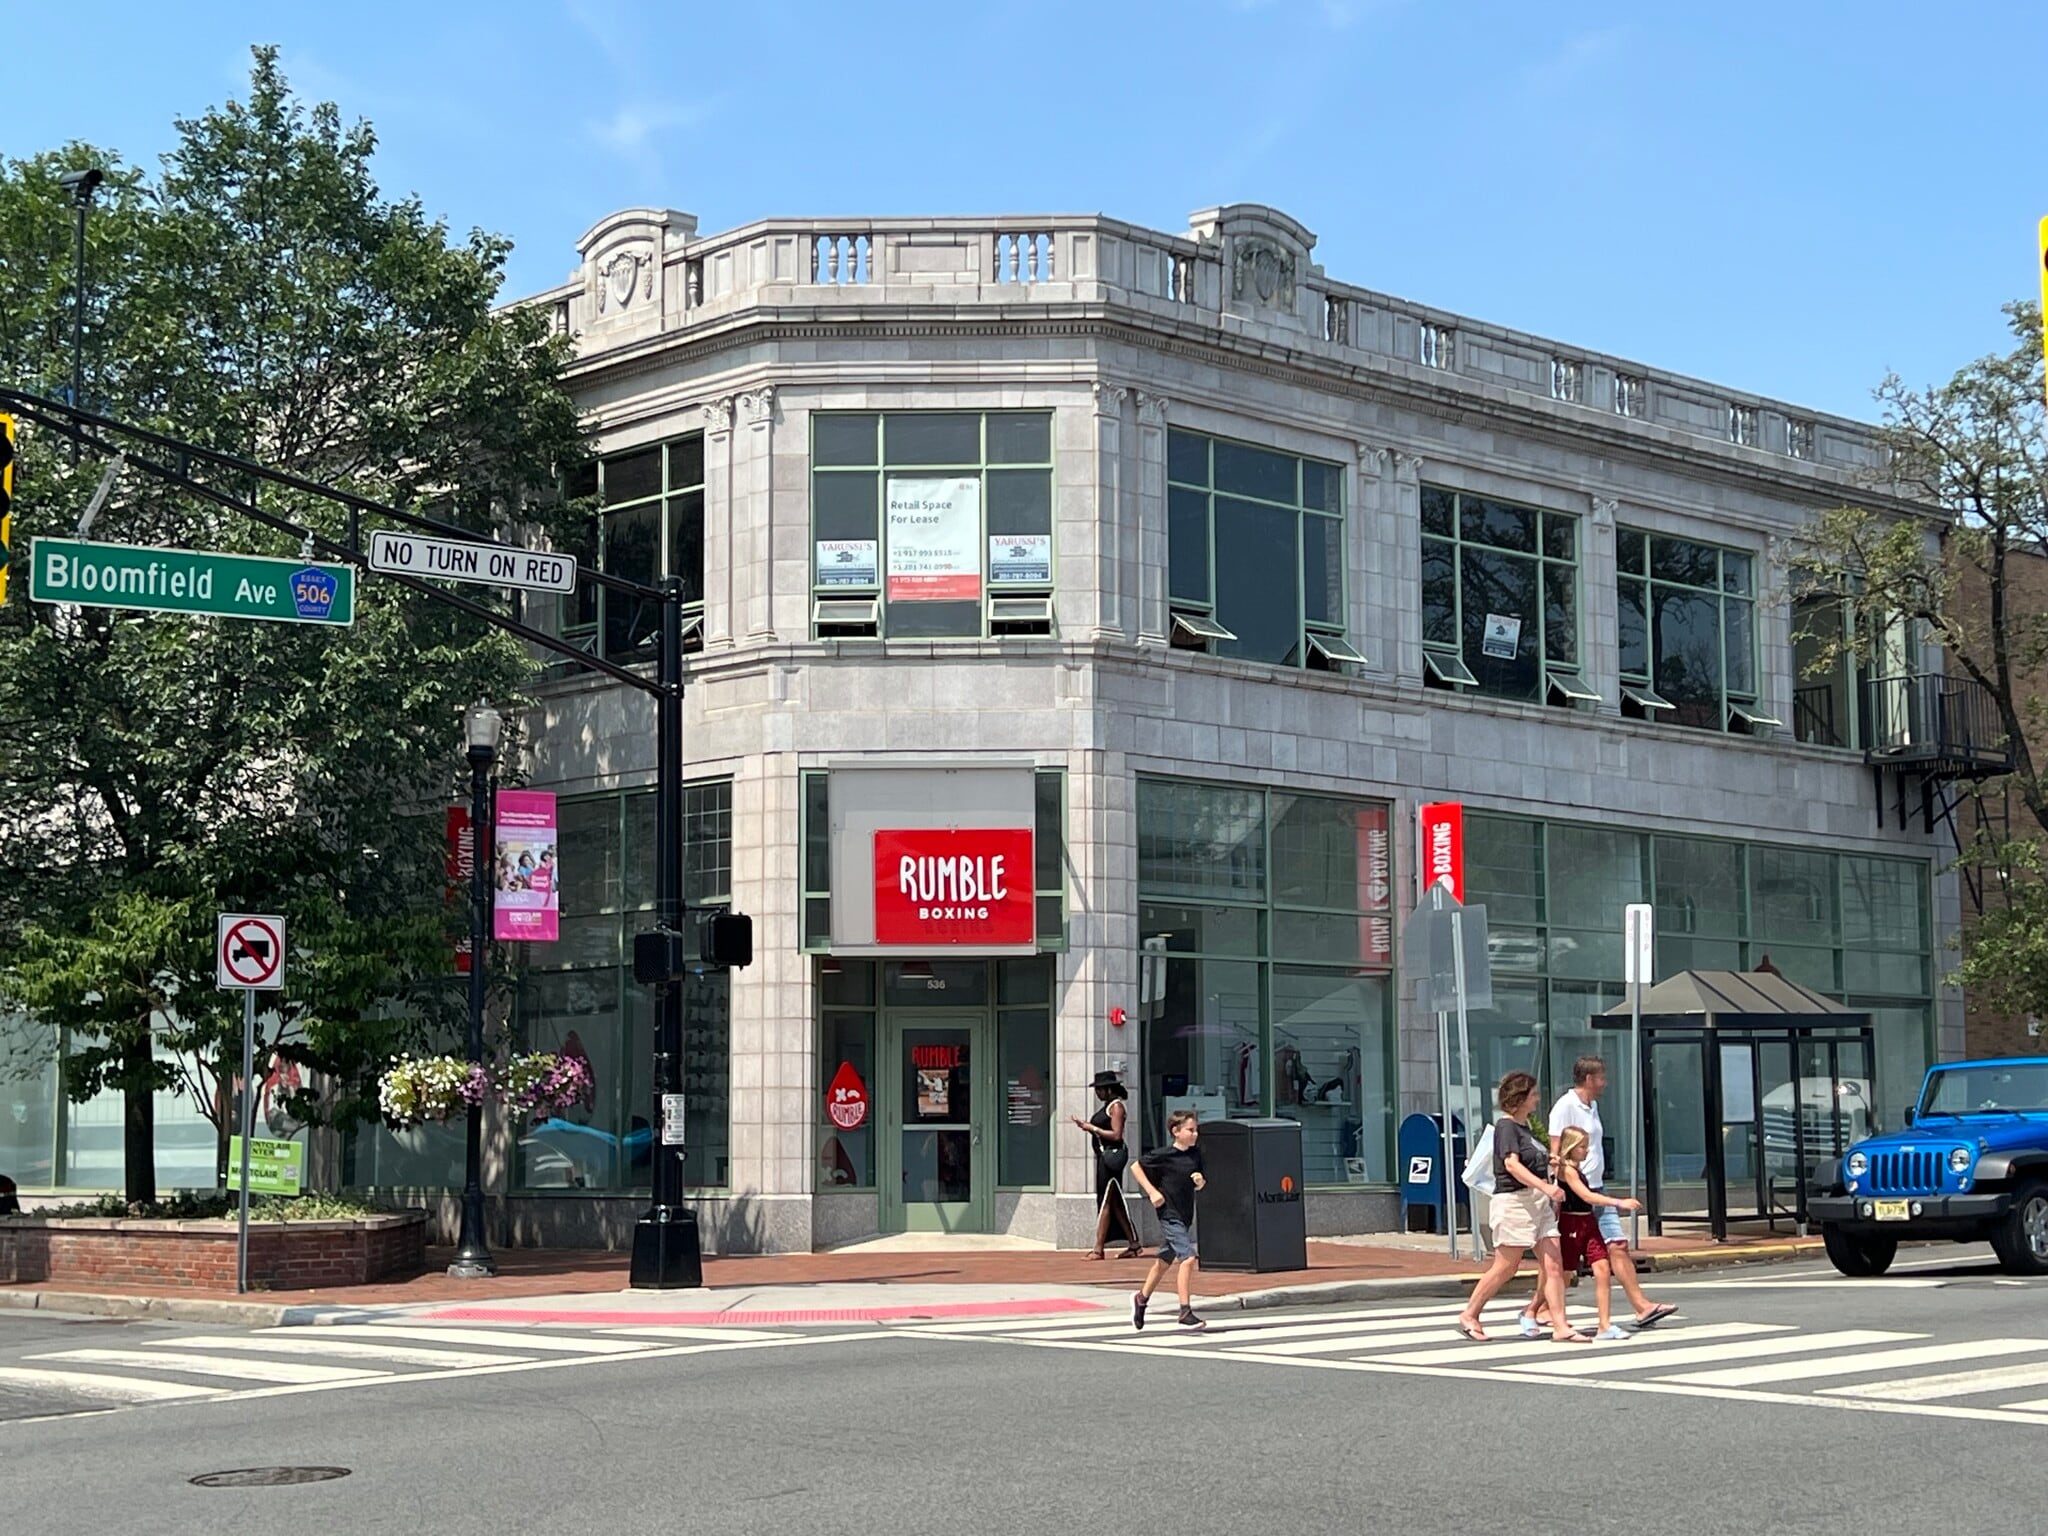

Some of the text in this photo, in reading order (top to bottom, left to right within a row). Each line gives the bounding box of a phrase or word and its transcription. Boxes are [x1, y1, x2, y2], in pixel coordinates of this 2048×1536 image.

[890, 500, 952, 511] Retail Space
[890, 515, 939, 524] For Lease
[383, 540, 563, 584] NO TURN ON RED
[46, 553, 277, 605] Bloomfield Ave
[297, 583, 330, 604] 506
[1432, 822, 1453, 874] BOXING
[900, 854, 1008, 902] RUMBLE
[919, 907, 988, 920] BOXING
